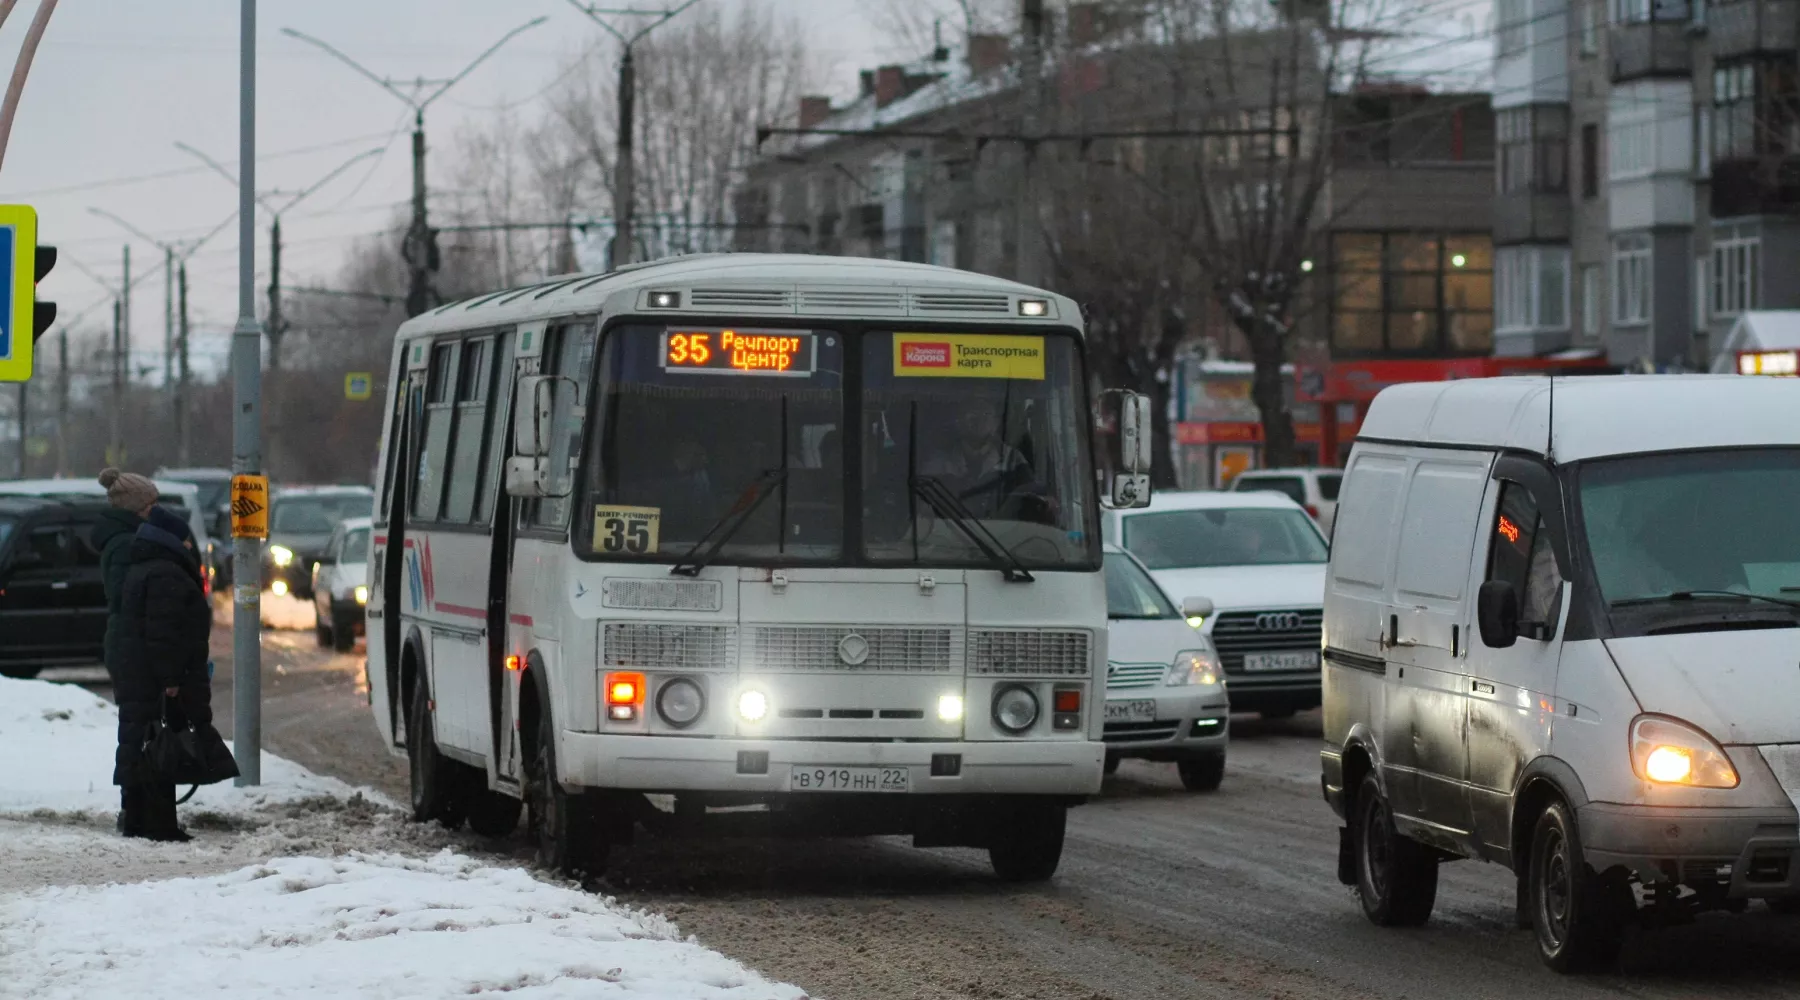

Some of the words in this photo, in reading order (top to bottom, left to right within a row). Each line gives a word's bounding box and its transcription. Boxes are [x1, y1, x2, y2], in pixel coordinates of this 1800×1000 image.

[669, 333, 711, 364] 35
[721, 330, 800, 352] Речпорт
[956, 344, 1039, 358] Транспортная
[732, 350, 790, 371] Центр
[906, 353, 946, 364] Корона
[957, 358, 992, 368] карта
[604, 518, 649, 553] 35
